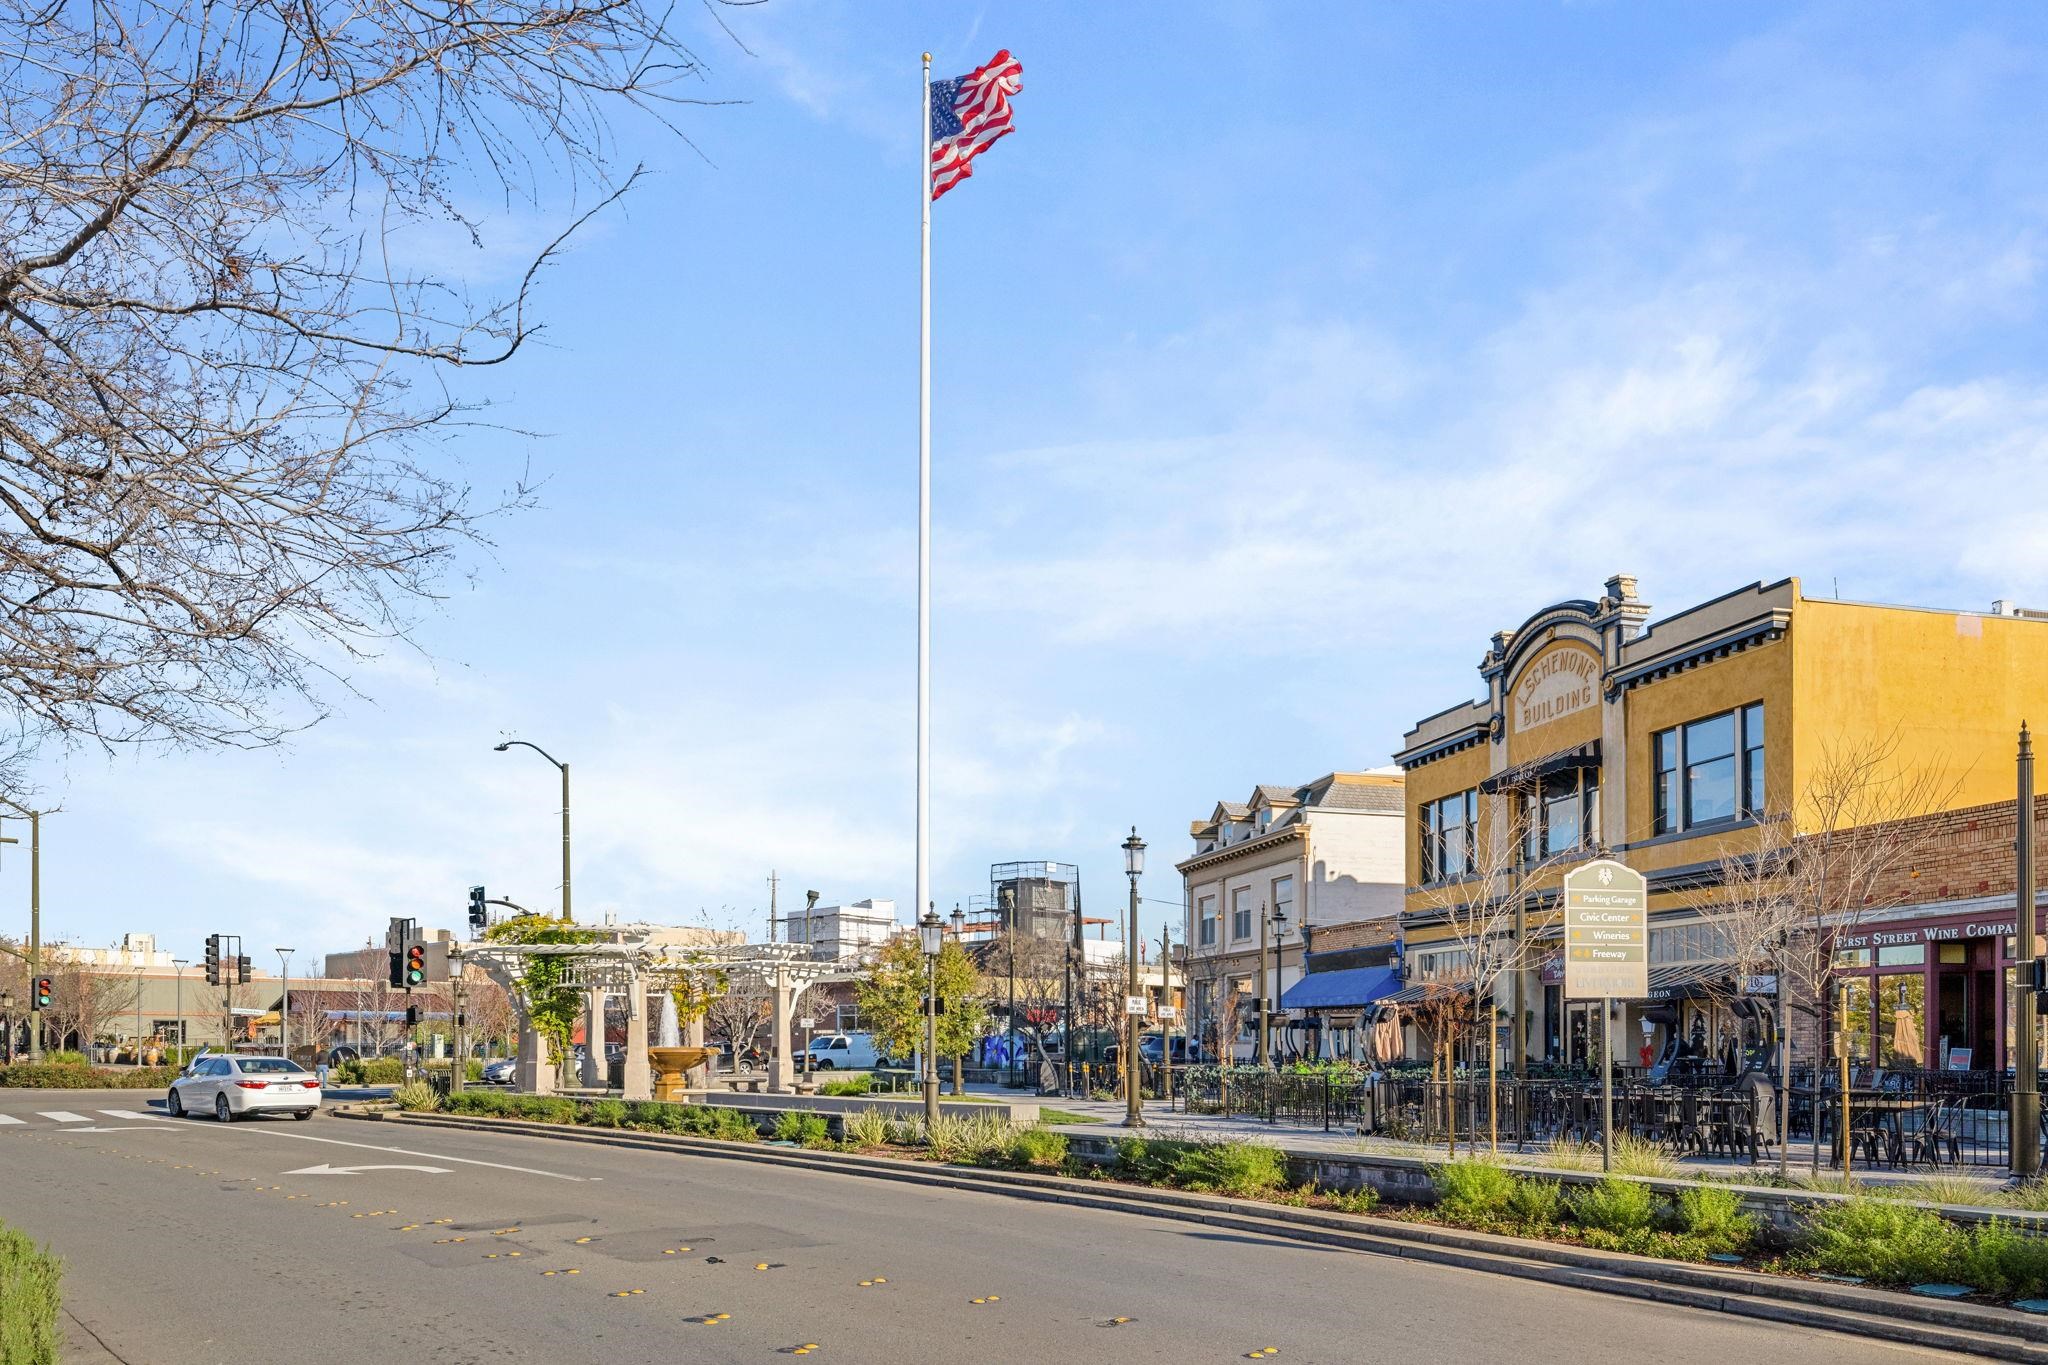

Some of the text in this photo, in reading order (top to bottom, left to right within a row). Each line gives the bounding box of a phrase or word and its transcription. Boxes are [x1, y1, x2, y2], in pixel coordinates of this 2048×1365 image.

[1525, 651, 1596, 693] SCHENONE
[1524, 685, 1591, 725] BUILDING
[1583, 894, 1636, 906] Parking Garage
[1580, 912, 1630, 922] Civic Center
[1593, 930, 1630, 940] Wineries
[1873, 932, 1918, 945] STREET
[1923, 928, 1958, 940] WINE
[1966, 924, 2016, 937] COMPA
[1592, 950, 1626, 960] Freeway
